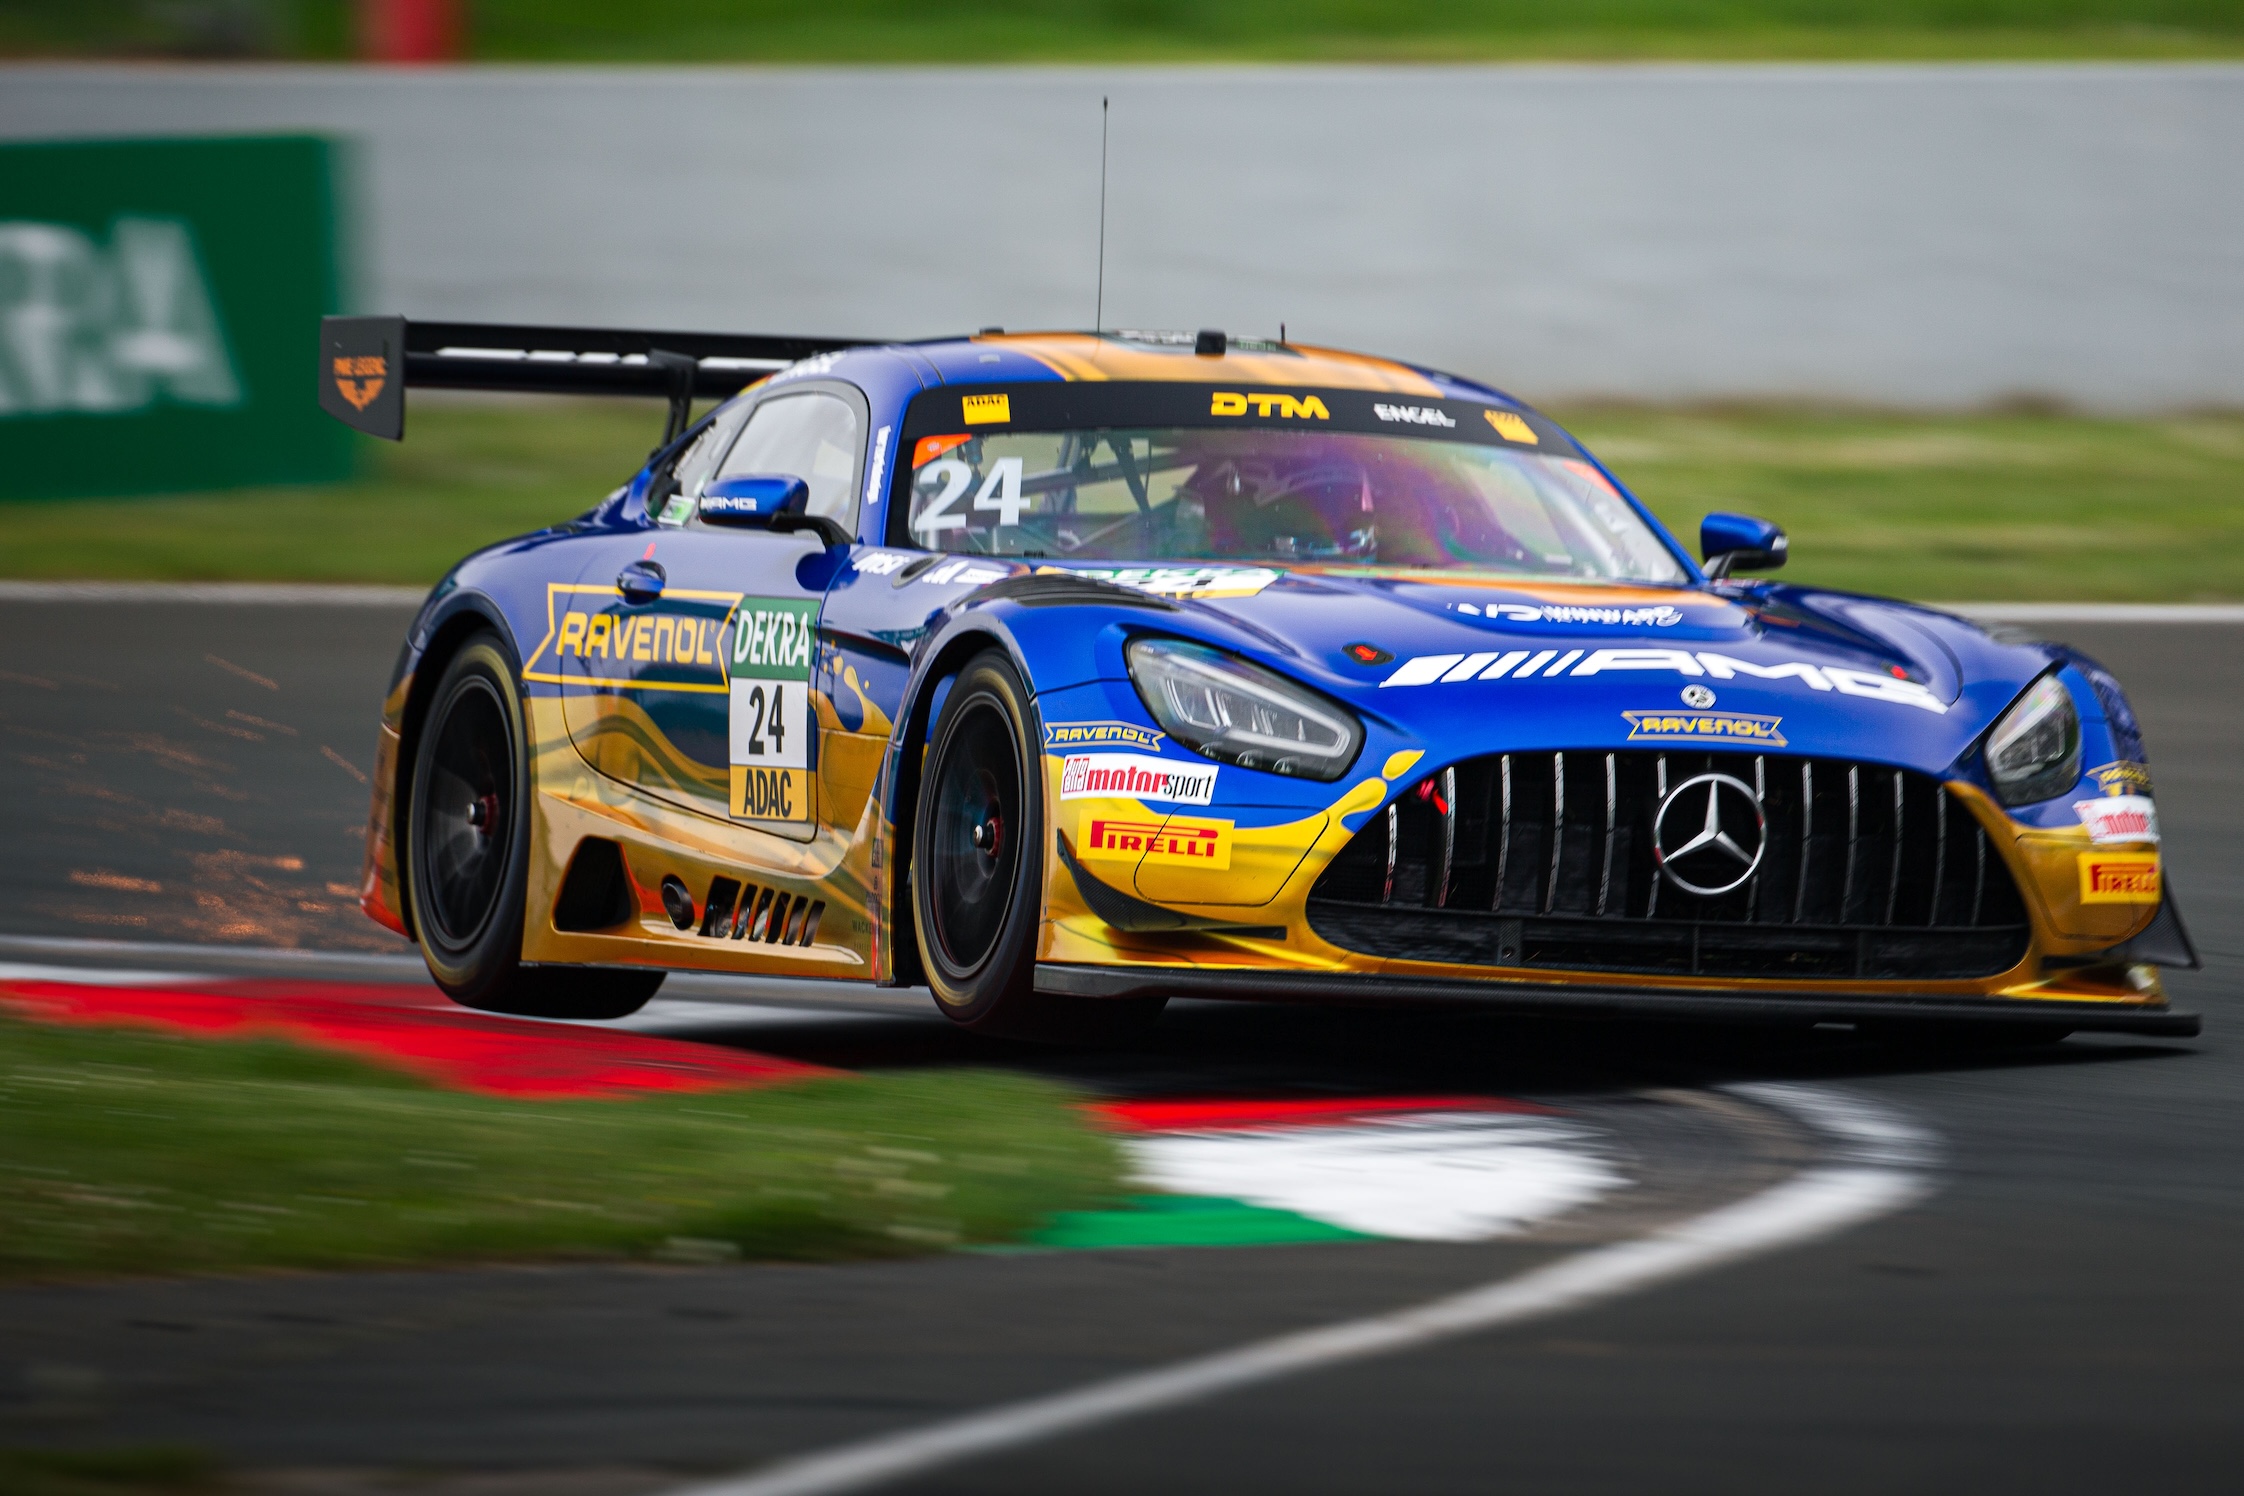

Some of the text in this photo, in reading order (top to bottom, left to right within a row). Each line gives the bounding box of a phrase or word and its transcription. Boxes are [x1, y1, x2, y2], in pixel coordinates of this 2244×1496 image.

[1211, 392, 1330, 420] DTM
[1374, 403, 1456, 428] ENGEL
[914, 456, 1031, 533] 24
[555, 612, 713, 665] RAVENOL
[733, 609, 810, 668] DEKRA
[1570, 648, 1949, 714] AMG
[747, 683, 786, 756] 24
[1055, 727, 1150, 744] RAVENOL
[1641, 716, 1772, 738] RAVENOL
[743, 768, 792, 818] ADAC
[1090, 820, 1219, 858] PIRELLI
